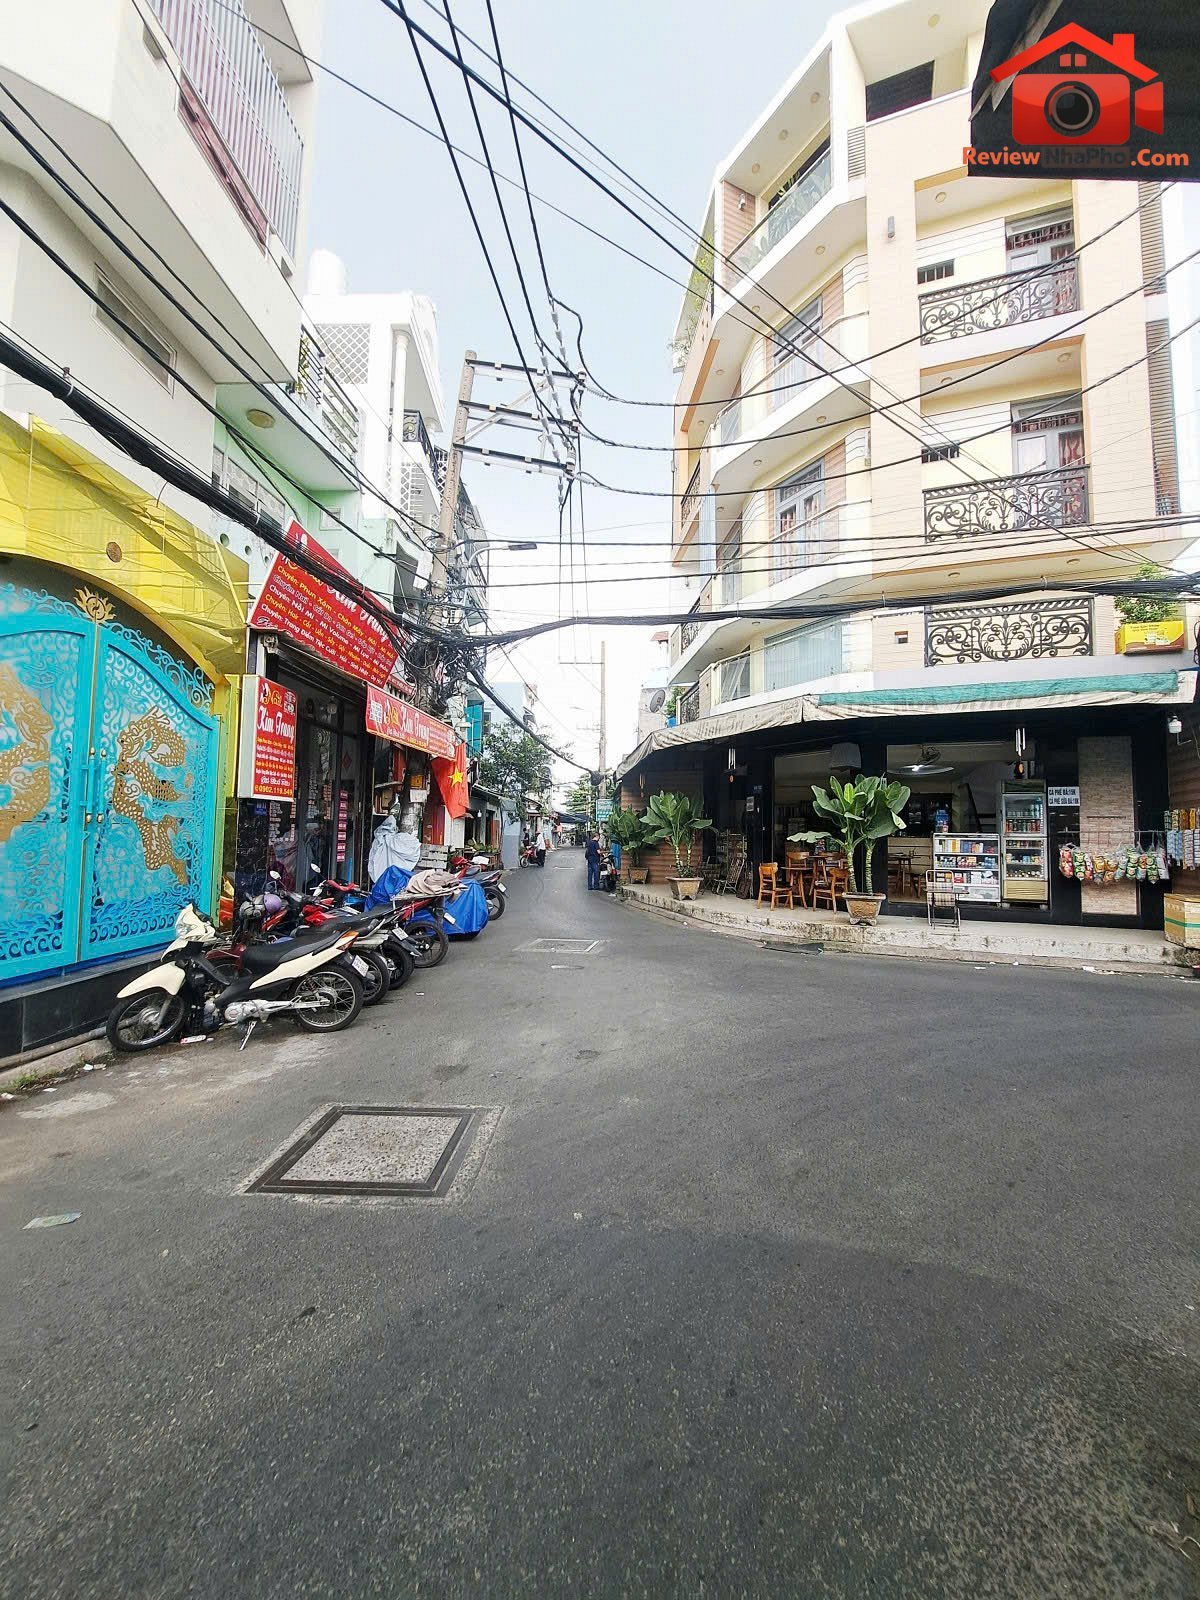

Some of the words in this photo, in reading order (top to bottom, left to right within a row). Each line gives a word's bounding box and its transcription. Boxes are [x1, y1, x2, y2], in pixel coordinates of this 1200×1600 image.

[300, 583, 316, 598] Phun
[284, 619, 300, 633] Trang
[329, 628, 348, 644] Volume
[257, 706, 275, 732] Kim
[275, 711, 295, 744] Trang
